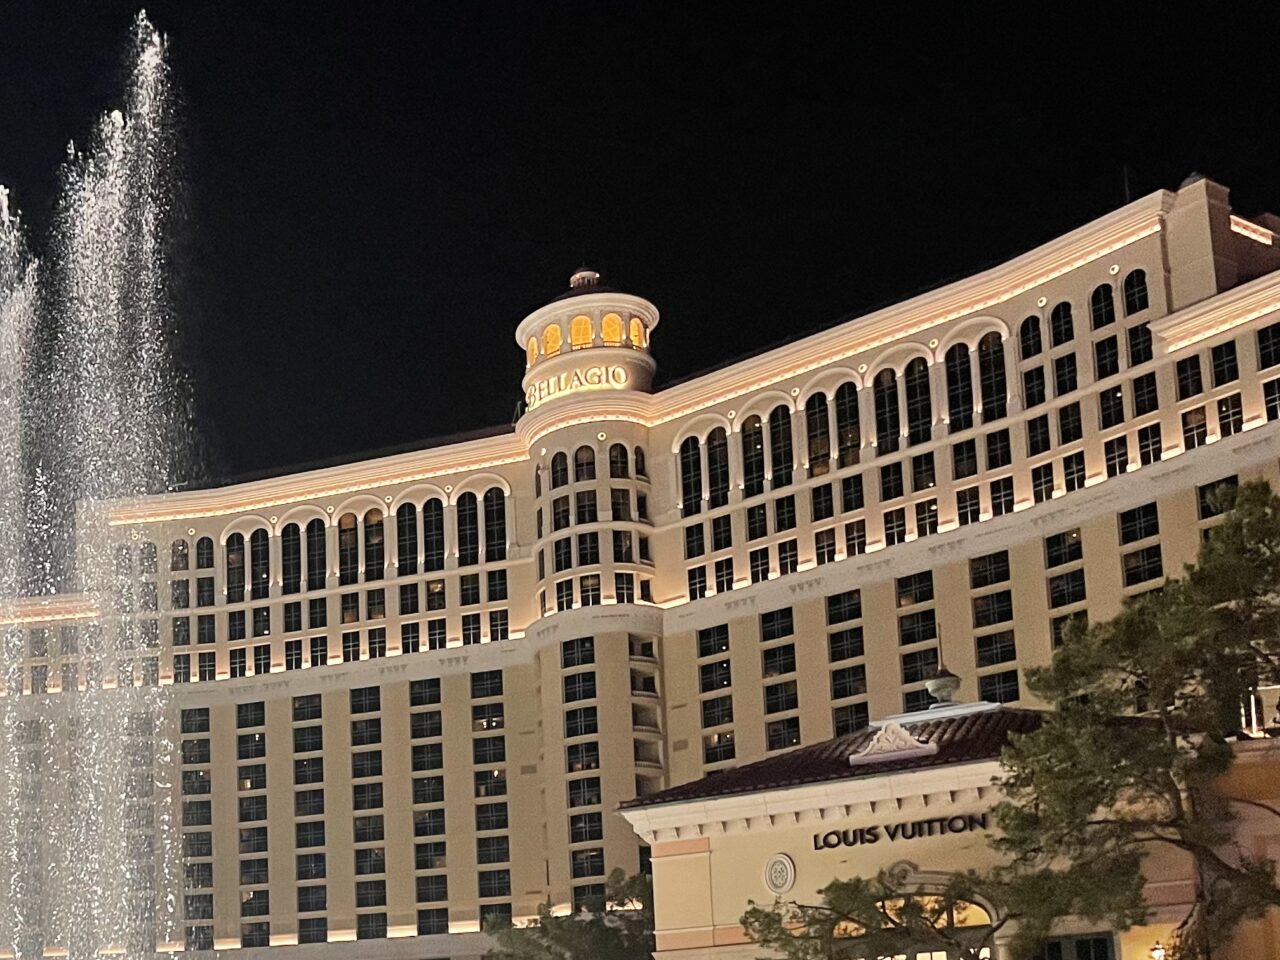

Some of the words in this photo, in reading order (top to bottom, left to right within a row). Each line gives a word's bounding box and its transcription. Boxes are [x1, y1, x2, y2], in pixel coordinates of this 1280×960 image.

[525, 366, 627, 408] BELLAGIO
[813, 825, 880, 851] LOUIS
[884, 813, 987, 842] VUITTON
